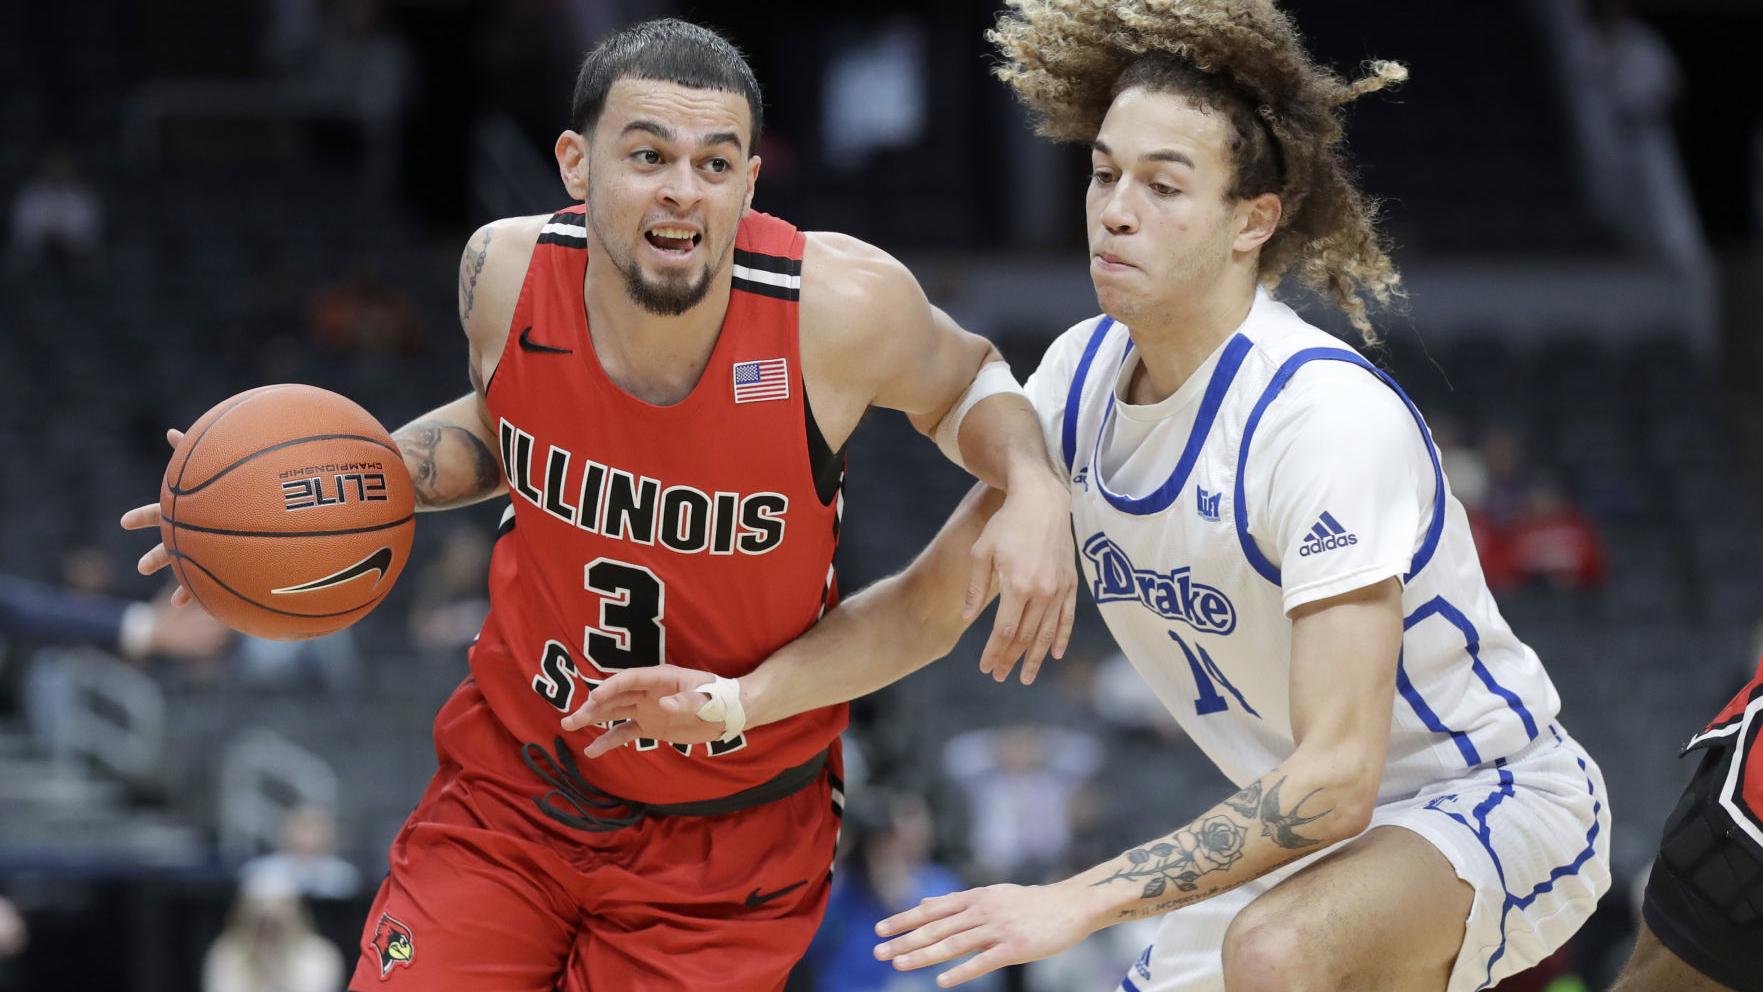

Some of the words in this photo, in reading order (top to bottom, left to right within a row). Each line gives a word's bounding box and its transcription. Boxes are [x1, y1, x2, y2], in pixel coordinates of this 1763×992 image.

[279, 462, 384, 479] CHAMPIONSHIP
[281, 473, 388, 512] ELITE
[499, 416, 790, 556] ILLINOIS
[1299, 532, 1358, 557] adidas
[583, 556, 666, 673] 3
[1084, 532, 1236, 635] Drake
